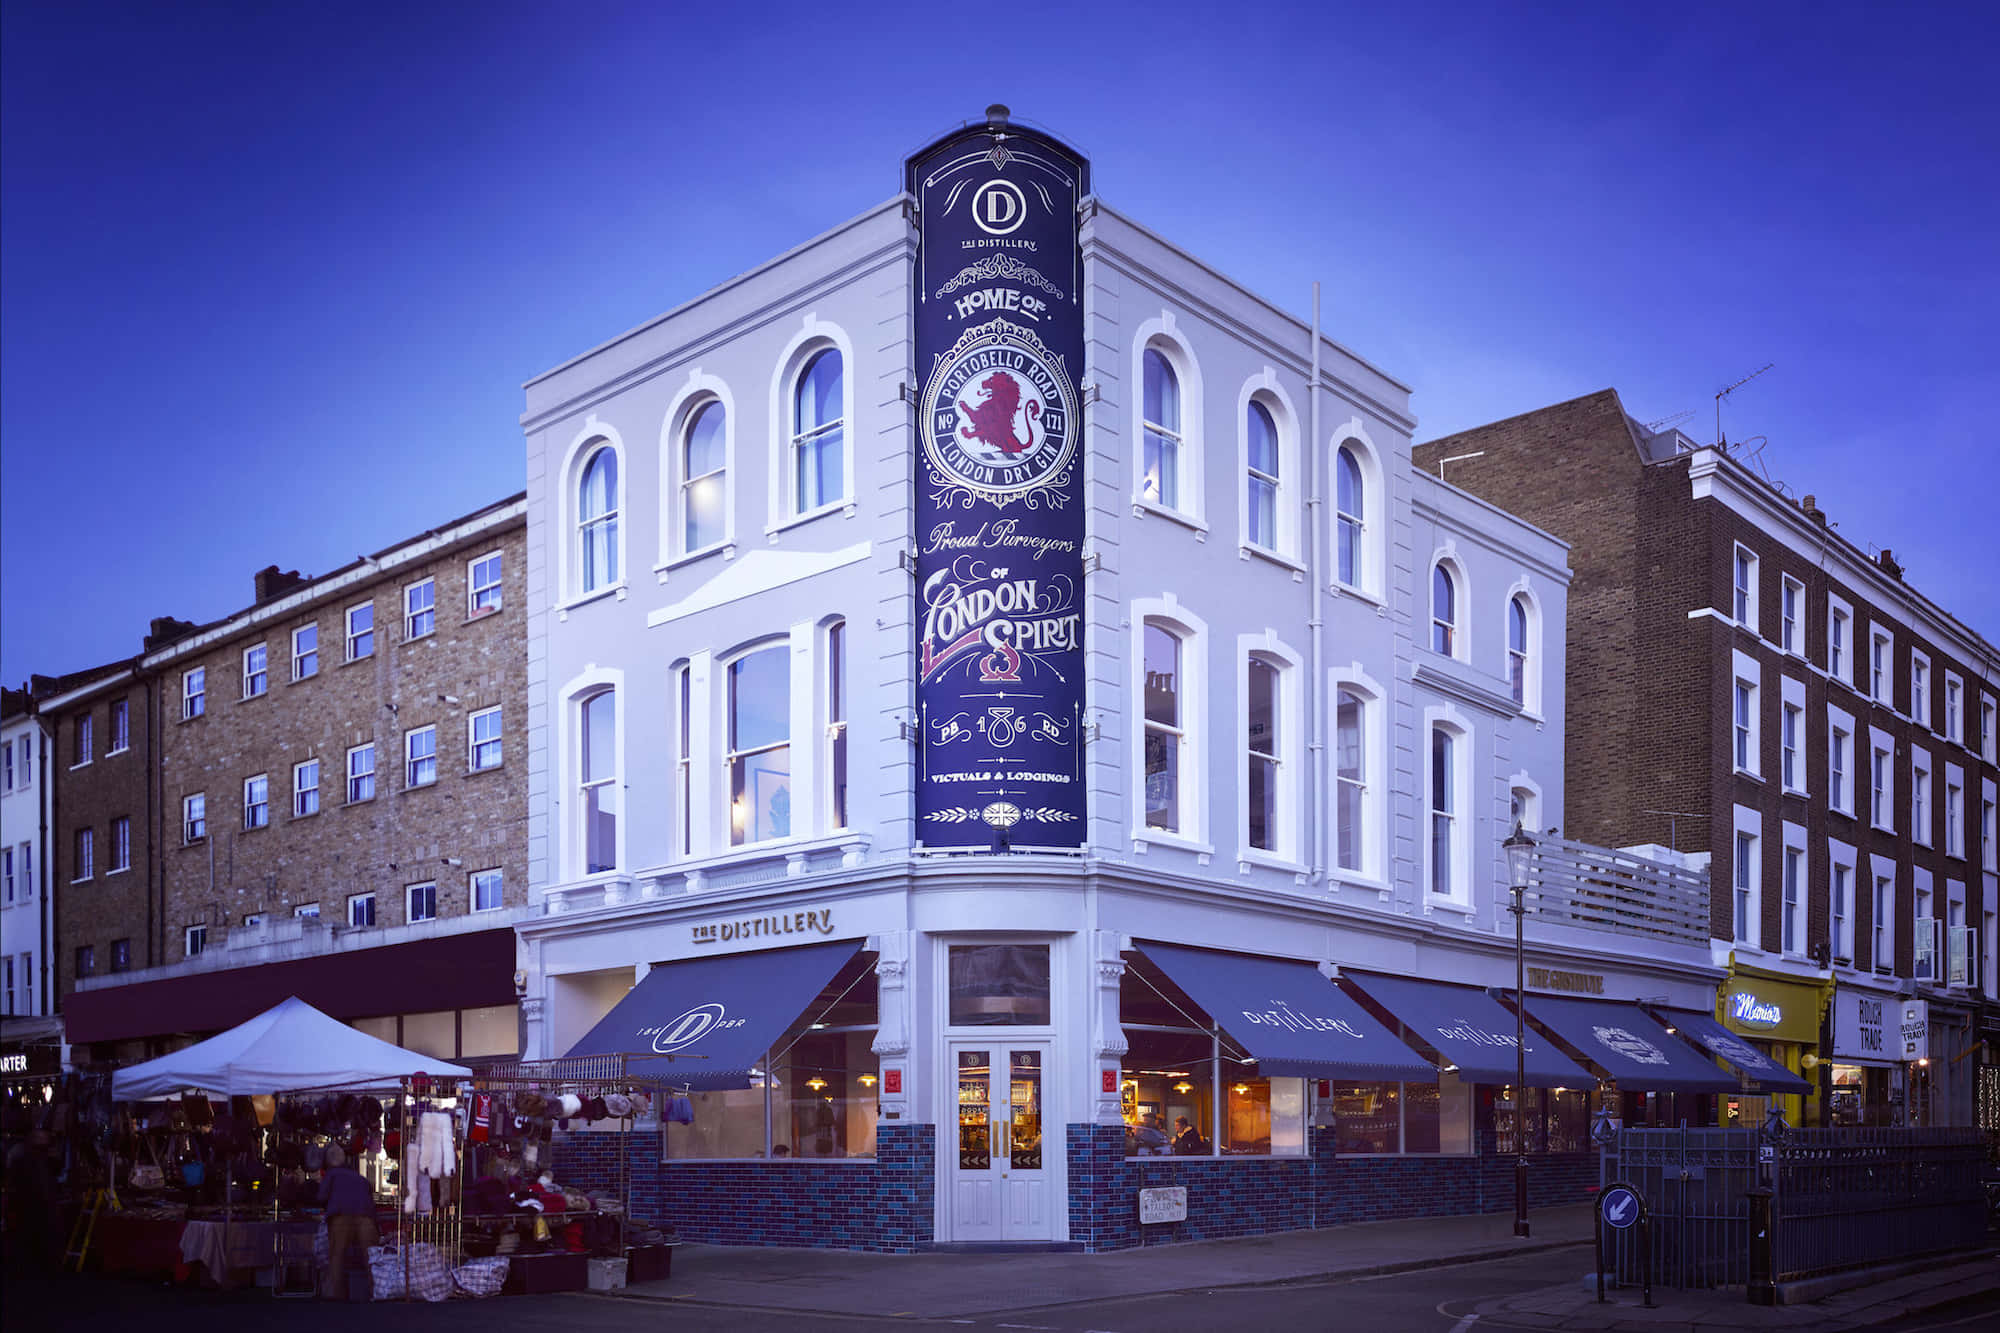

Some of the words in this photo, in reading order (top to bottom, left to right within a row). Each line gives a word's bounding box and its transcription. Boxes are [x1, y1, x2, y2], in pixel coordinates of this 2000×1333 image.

[961, 239, 975, 249] THE
[978, 238, 1038, 252] DISTILLERY
[954, 288, 1020, 319] HOME
[1020, 295, 1047, 314] OF
[942, 351, 1024, 400] PORTOBELLO
[1027, 363, 1058, 400] ROAD
[1046, 414, 1062, 430] 171
[941, 441, 995, 483] LONDON
[1003, 467, 1033, 484] DRY
[1034, 443, 1059, 469] GIN
[923, 520, 988, 554] Proud
[983, 519, 1075, 560] Purveyors
[990, 567, 1009, 579] OF
[920, 568, 1039, 685] LONDON
[979, 613, 1080, 682] SPIRIT
[941, 720, 960, 741] PB
[1042, 719, 1060, 738] RD
[931, 771, 992, 784] VICTUALS
[1007, 771, 1071, 784] LODGINGS
[692, 925, 717, 944] THE
[720, 909, 835, 941] DISTILLERY
[717, 1018, 746, 1030] PBR
[1242, 1007, 1364, 1039] DISTILLERY
[1859, 999, 1882, 1026] ROUGH
[1860, 1027, 1883, 1052] TRADE
